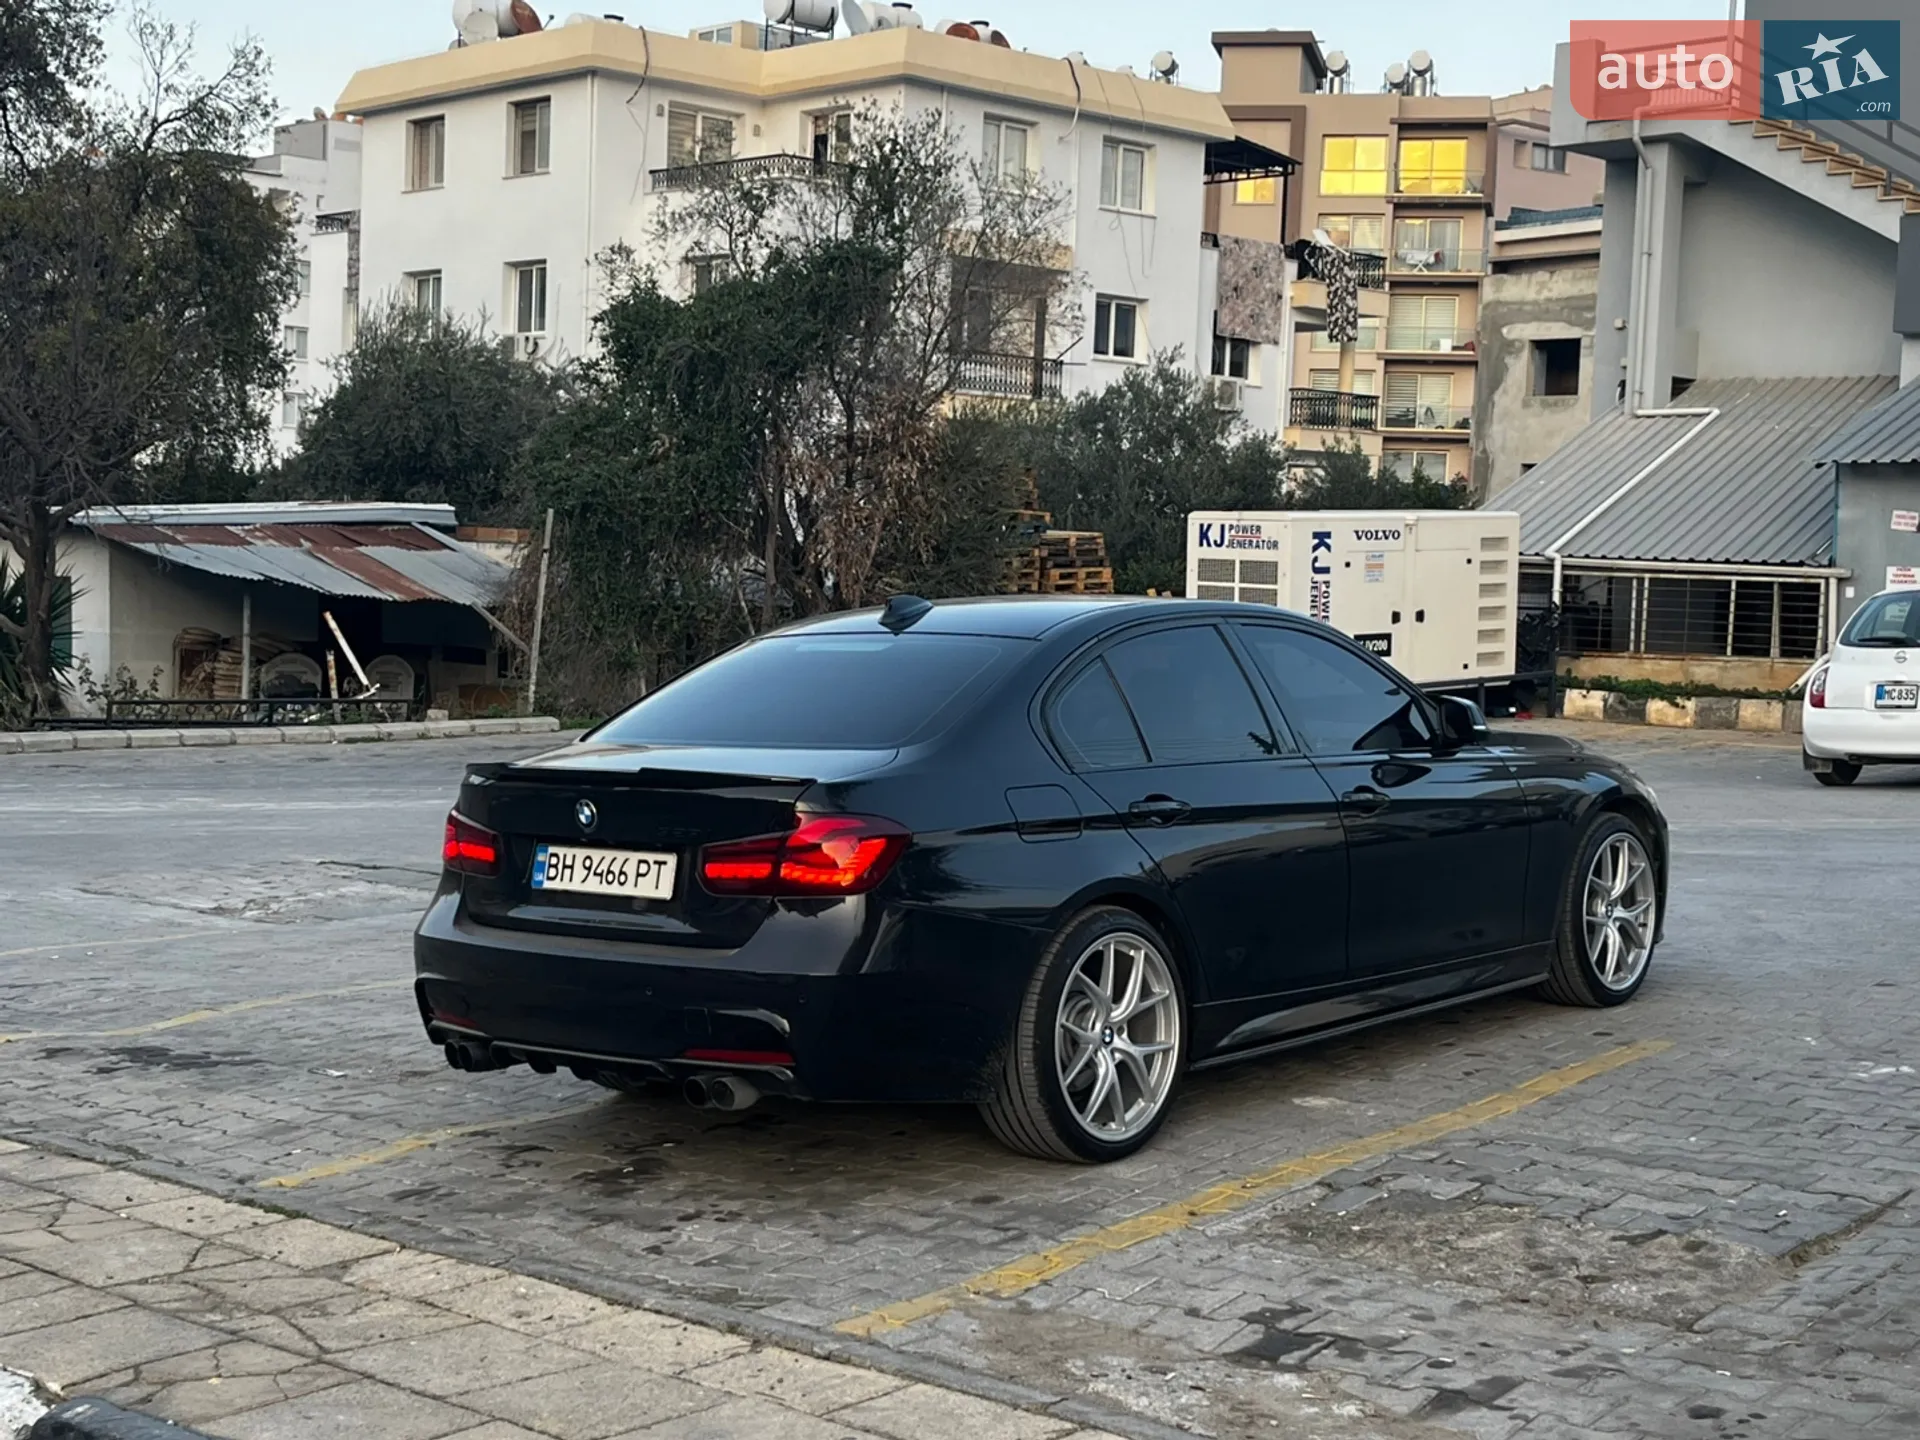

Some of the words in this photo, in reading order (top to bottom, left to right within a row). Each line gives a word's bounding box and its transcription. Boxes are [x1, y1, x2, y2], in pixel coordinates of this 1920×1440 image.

[1199, 523, 1225, 548] KJ
[1228, 524, 1262, 535] POWER
[1353, 529, 1401, 541] VOLVO
[1312, 531, 1332, 574] KJ
[1897, 688, 1916, 701] 835
[546, 852, 576, 883] BH
[580, 855, 630, 886] 9466
[634, 859, 668, 889] PT
